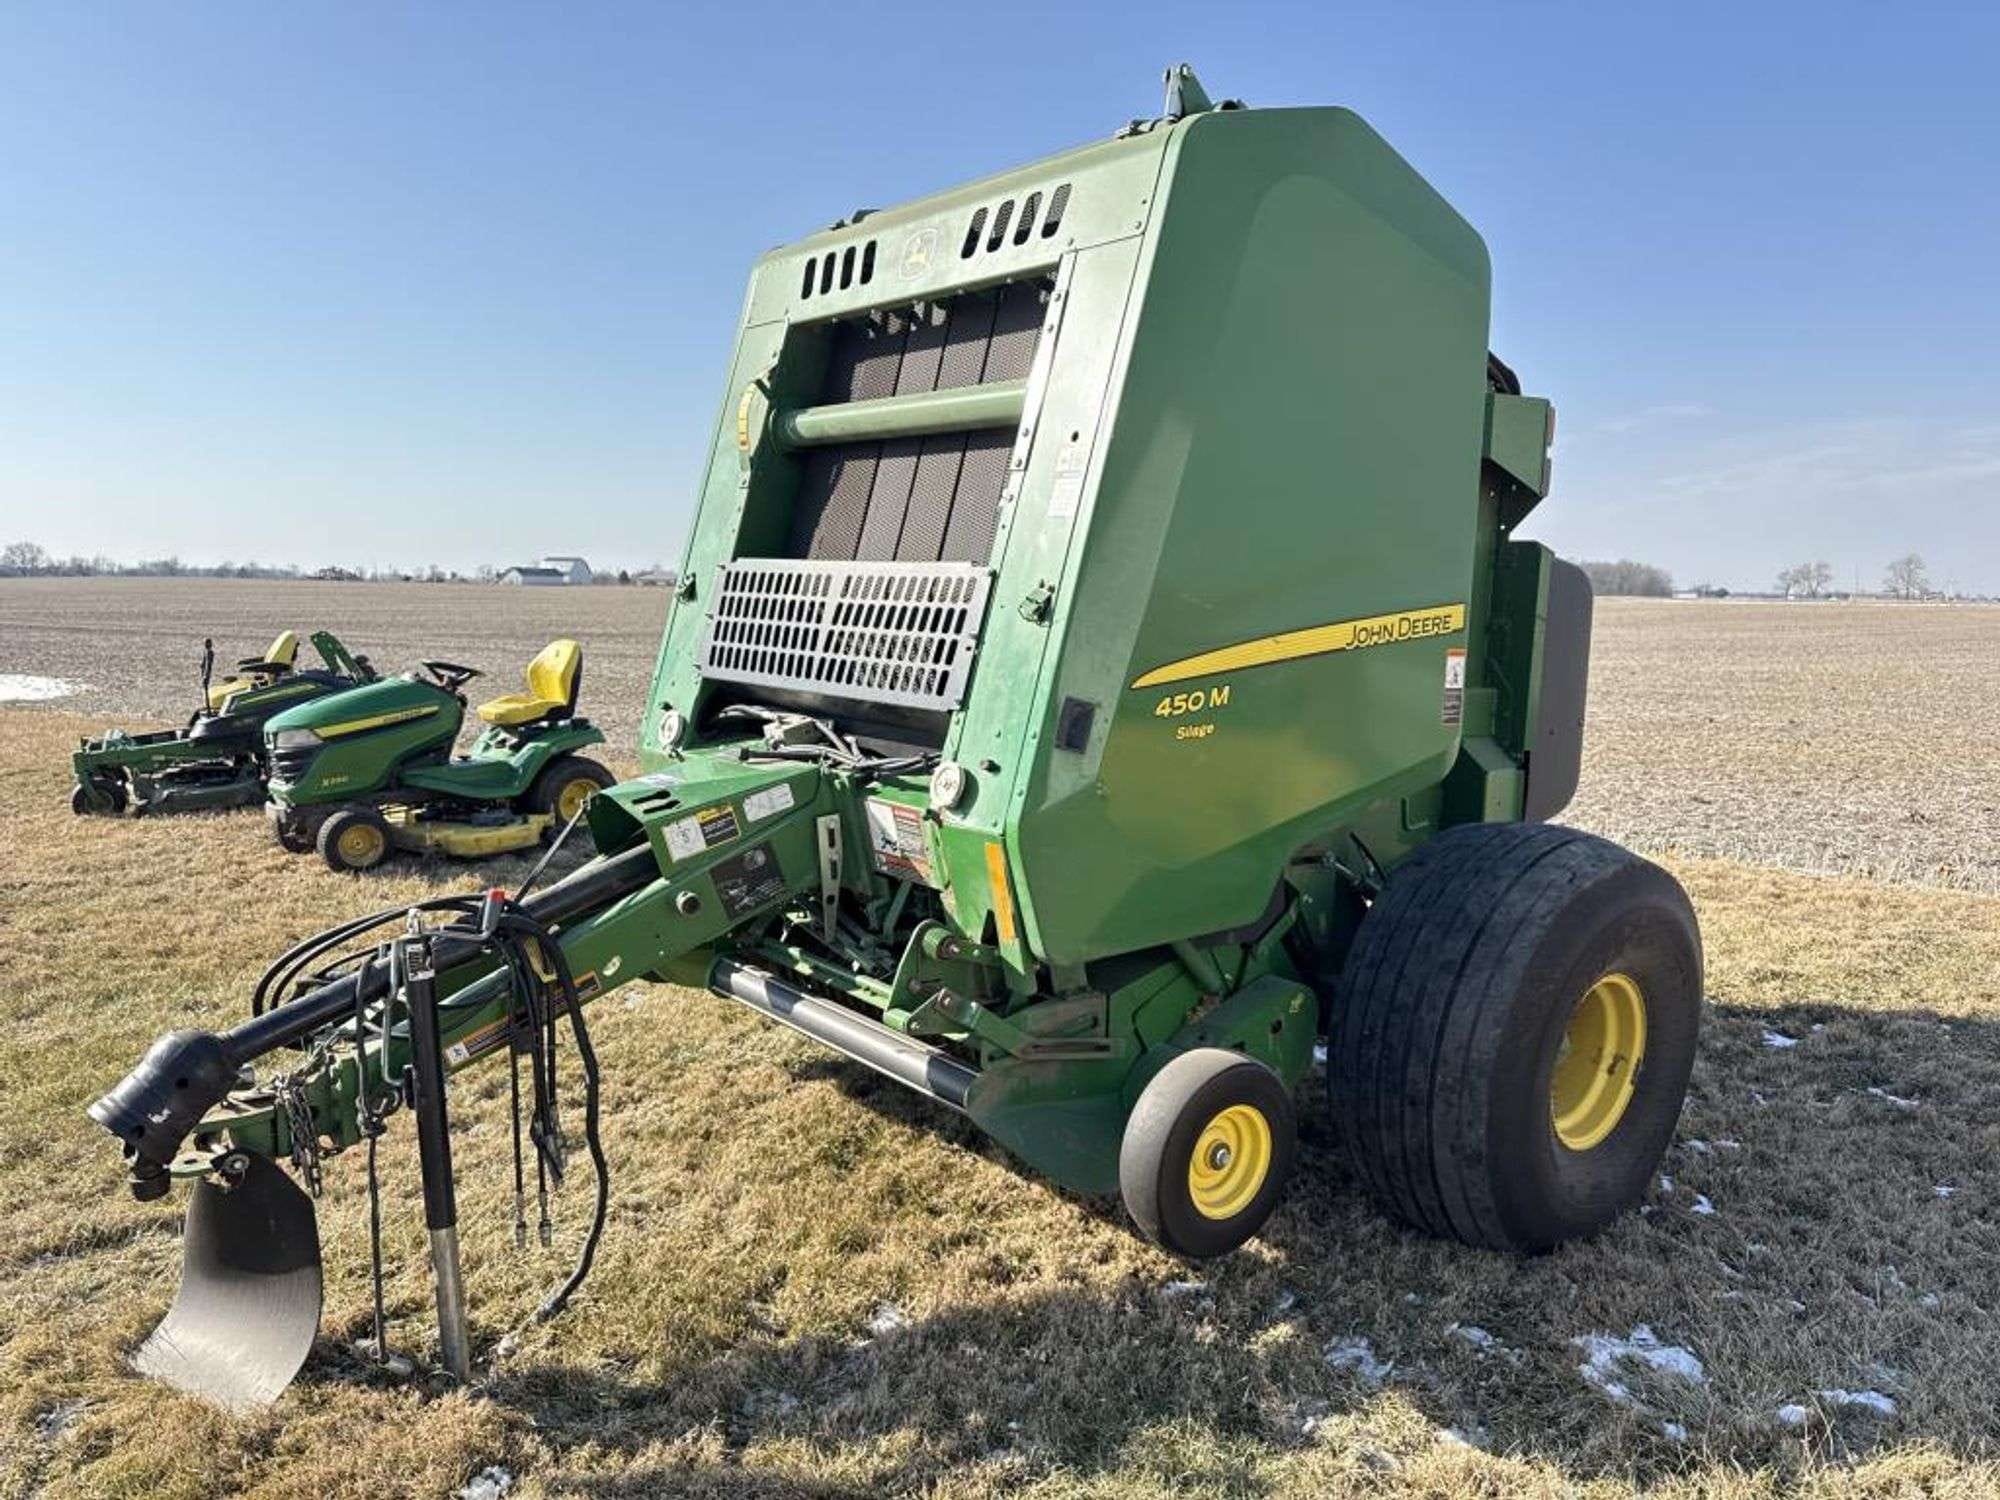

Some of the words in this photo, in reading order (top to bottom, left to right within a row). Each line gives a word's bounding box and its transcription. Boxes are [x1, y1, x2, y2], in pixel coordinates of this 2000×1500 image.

[1346, 623, 1394, 647] JOHN
[1398, 614, 1452, 638] DEERE
[1155, 691, 1205, 717] 450
[1209, 685, 1230, 708] M
